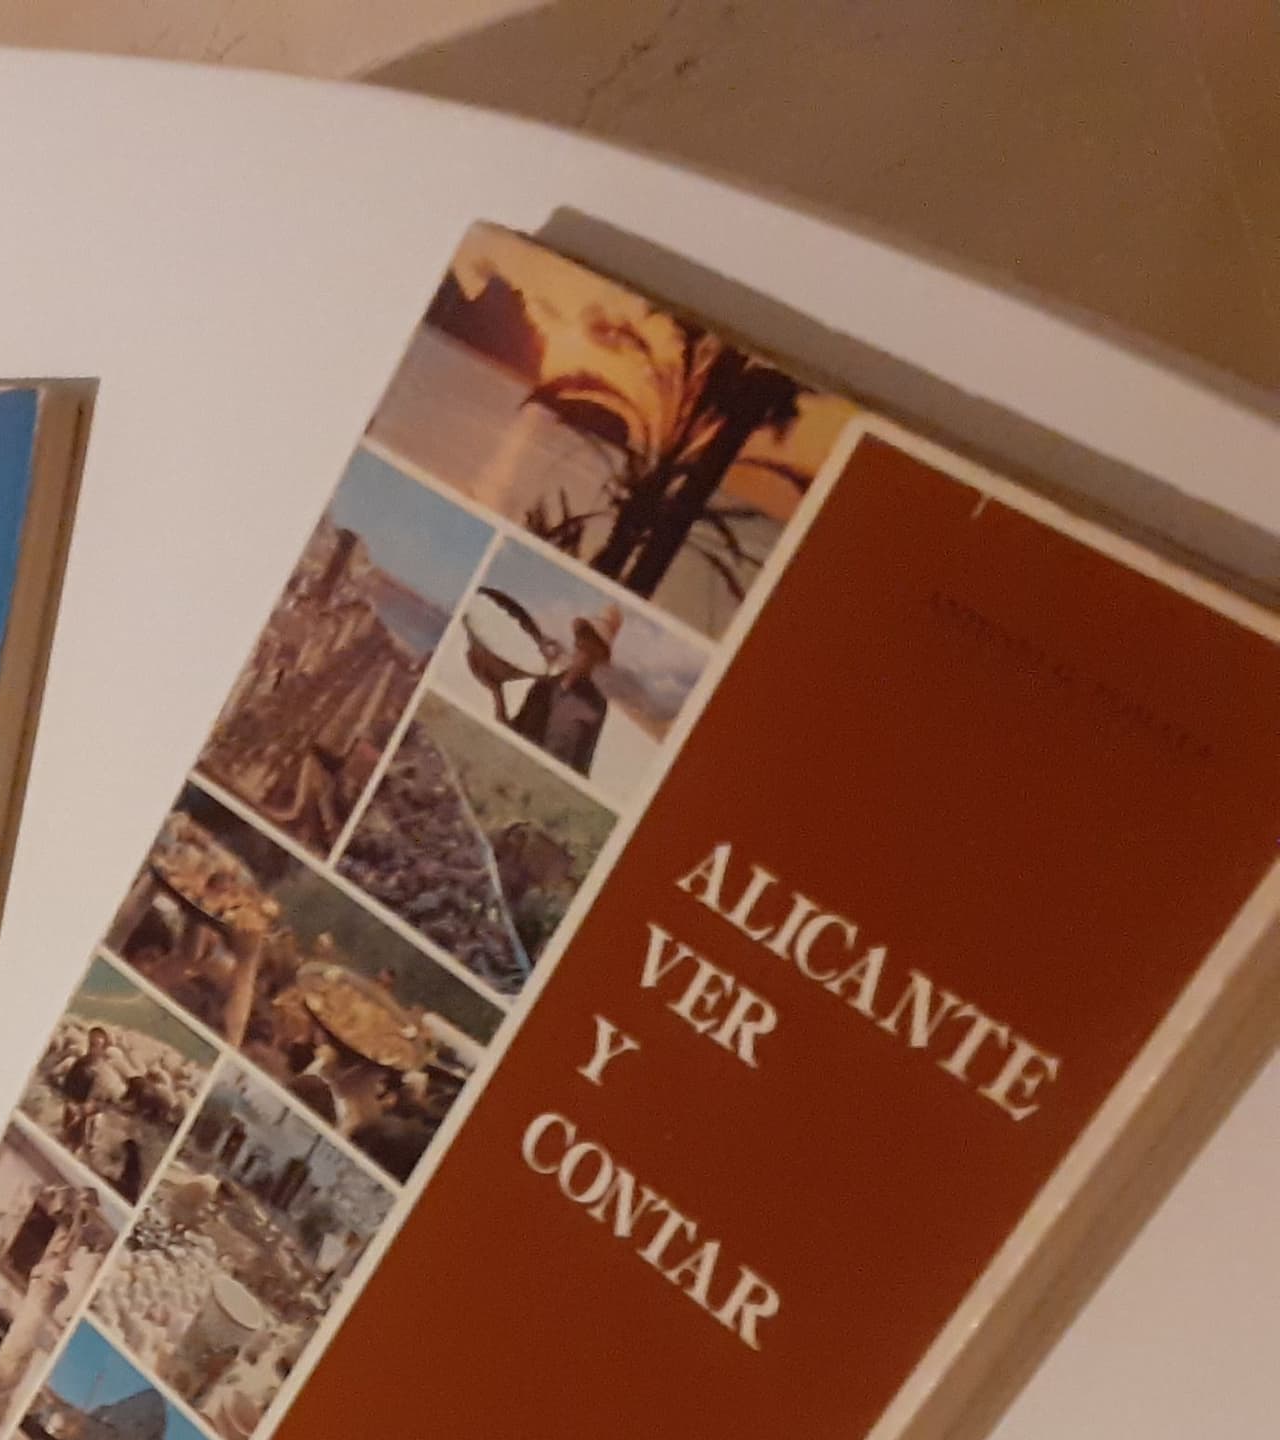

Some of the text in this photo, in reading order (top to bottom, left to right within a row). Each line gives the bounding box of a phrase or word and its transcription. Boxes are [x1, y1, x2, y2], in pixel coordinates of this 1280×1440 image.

[577, 1014, 640, 1086] Y
[638, 922, 779, 1068] VER
[675, 842, 1062, 1122] ALICANTE
[521, 1112, 781, 1350] CONTAR
